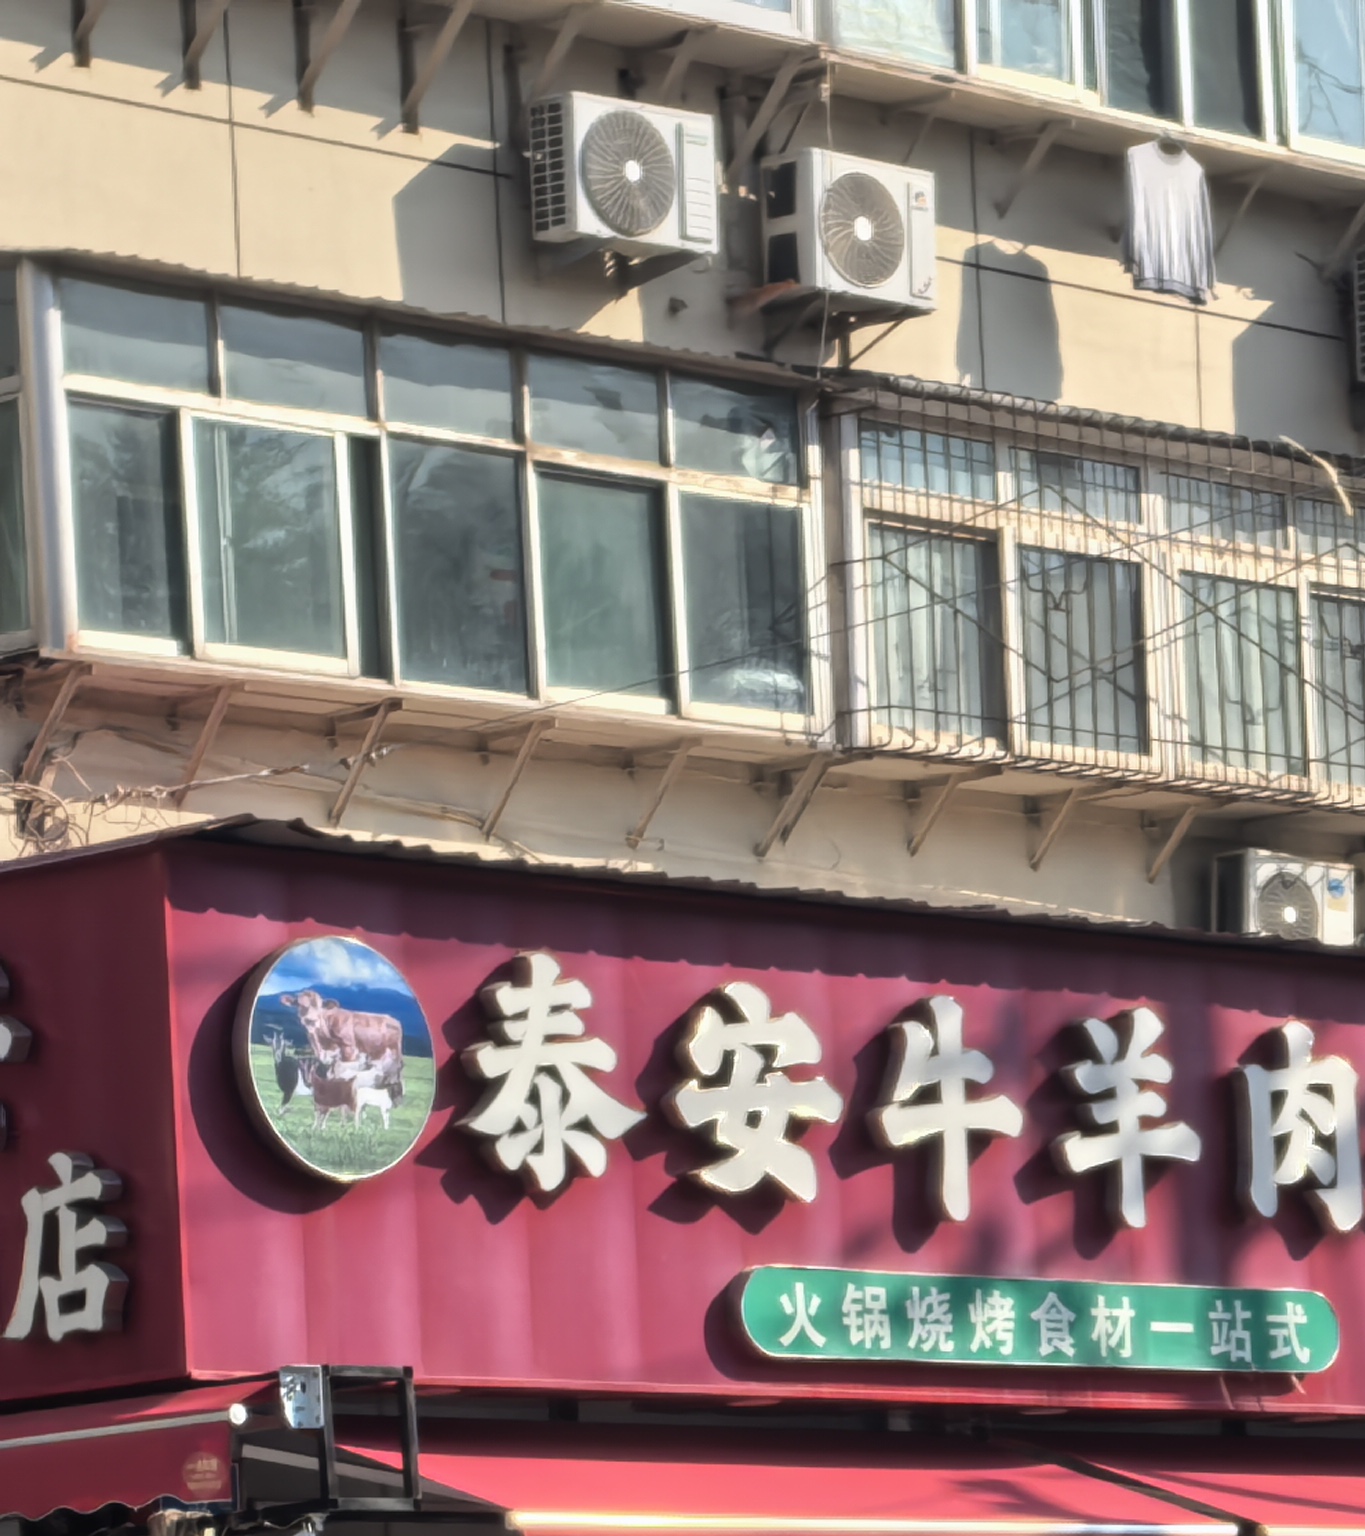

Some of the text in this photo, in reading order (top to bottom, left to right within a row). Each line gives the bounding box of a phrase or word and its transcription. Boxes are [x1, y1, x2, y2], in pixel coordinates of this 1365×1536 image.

[777, 1284, 1312, 1365] 火锅烧烤食材一站式
